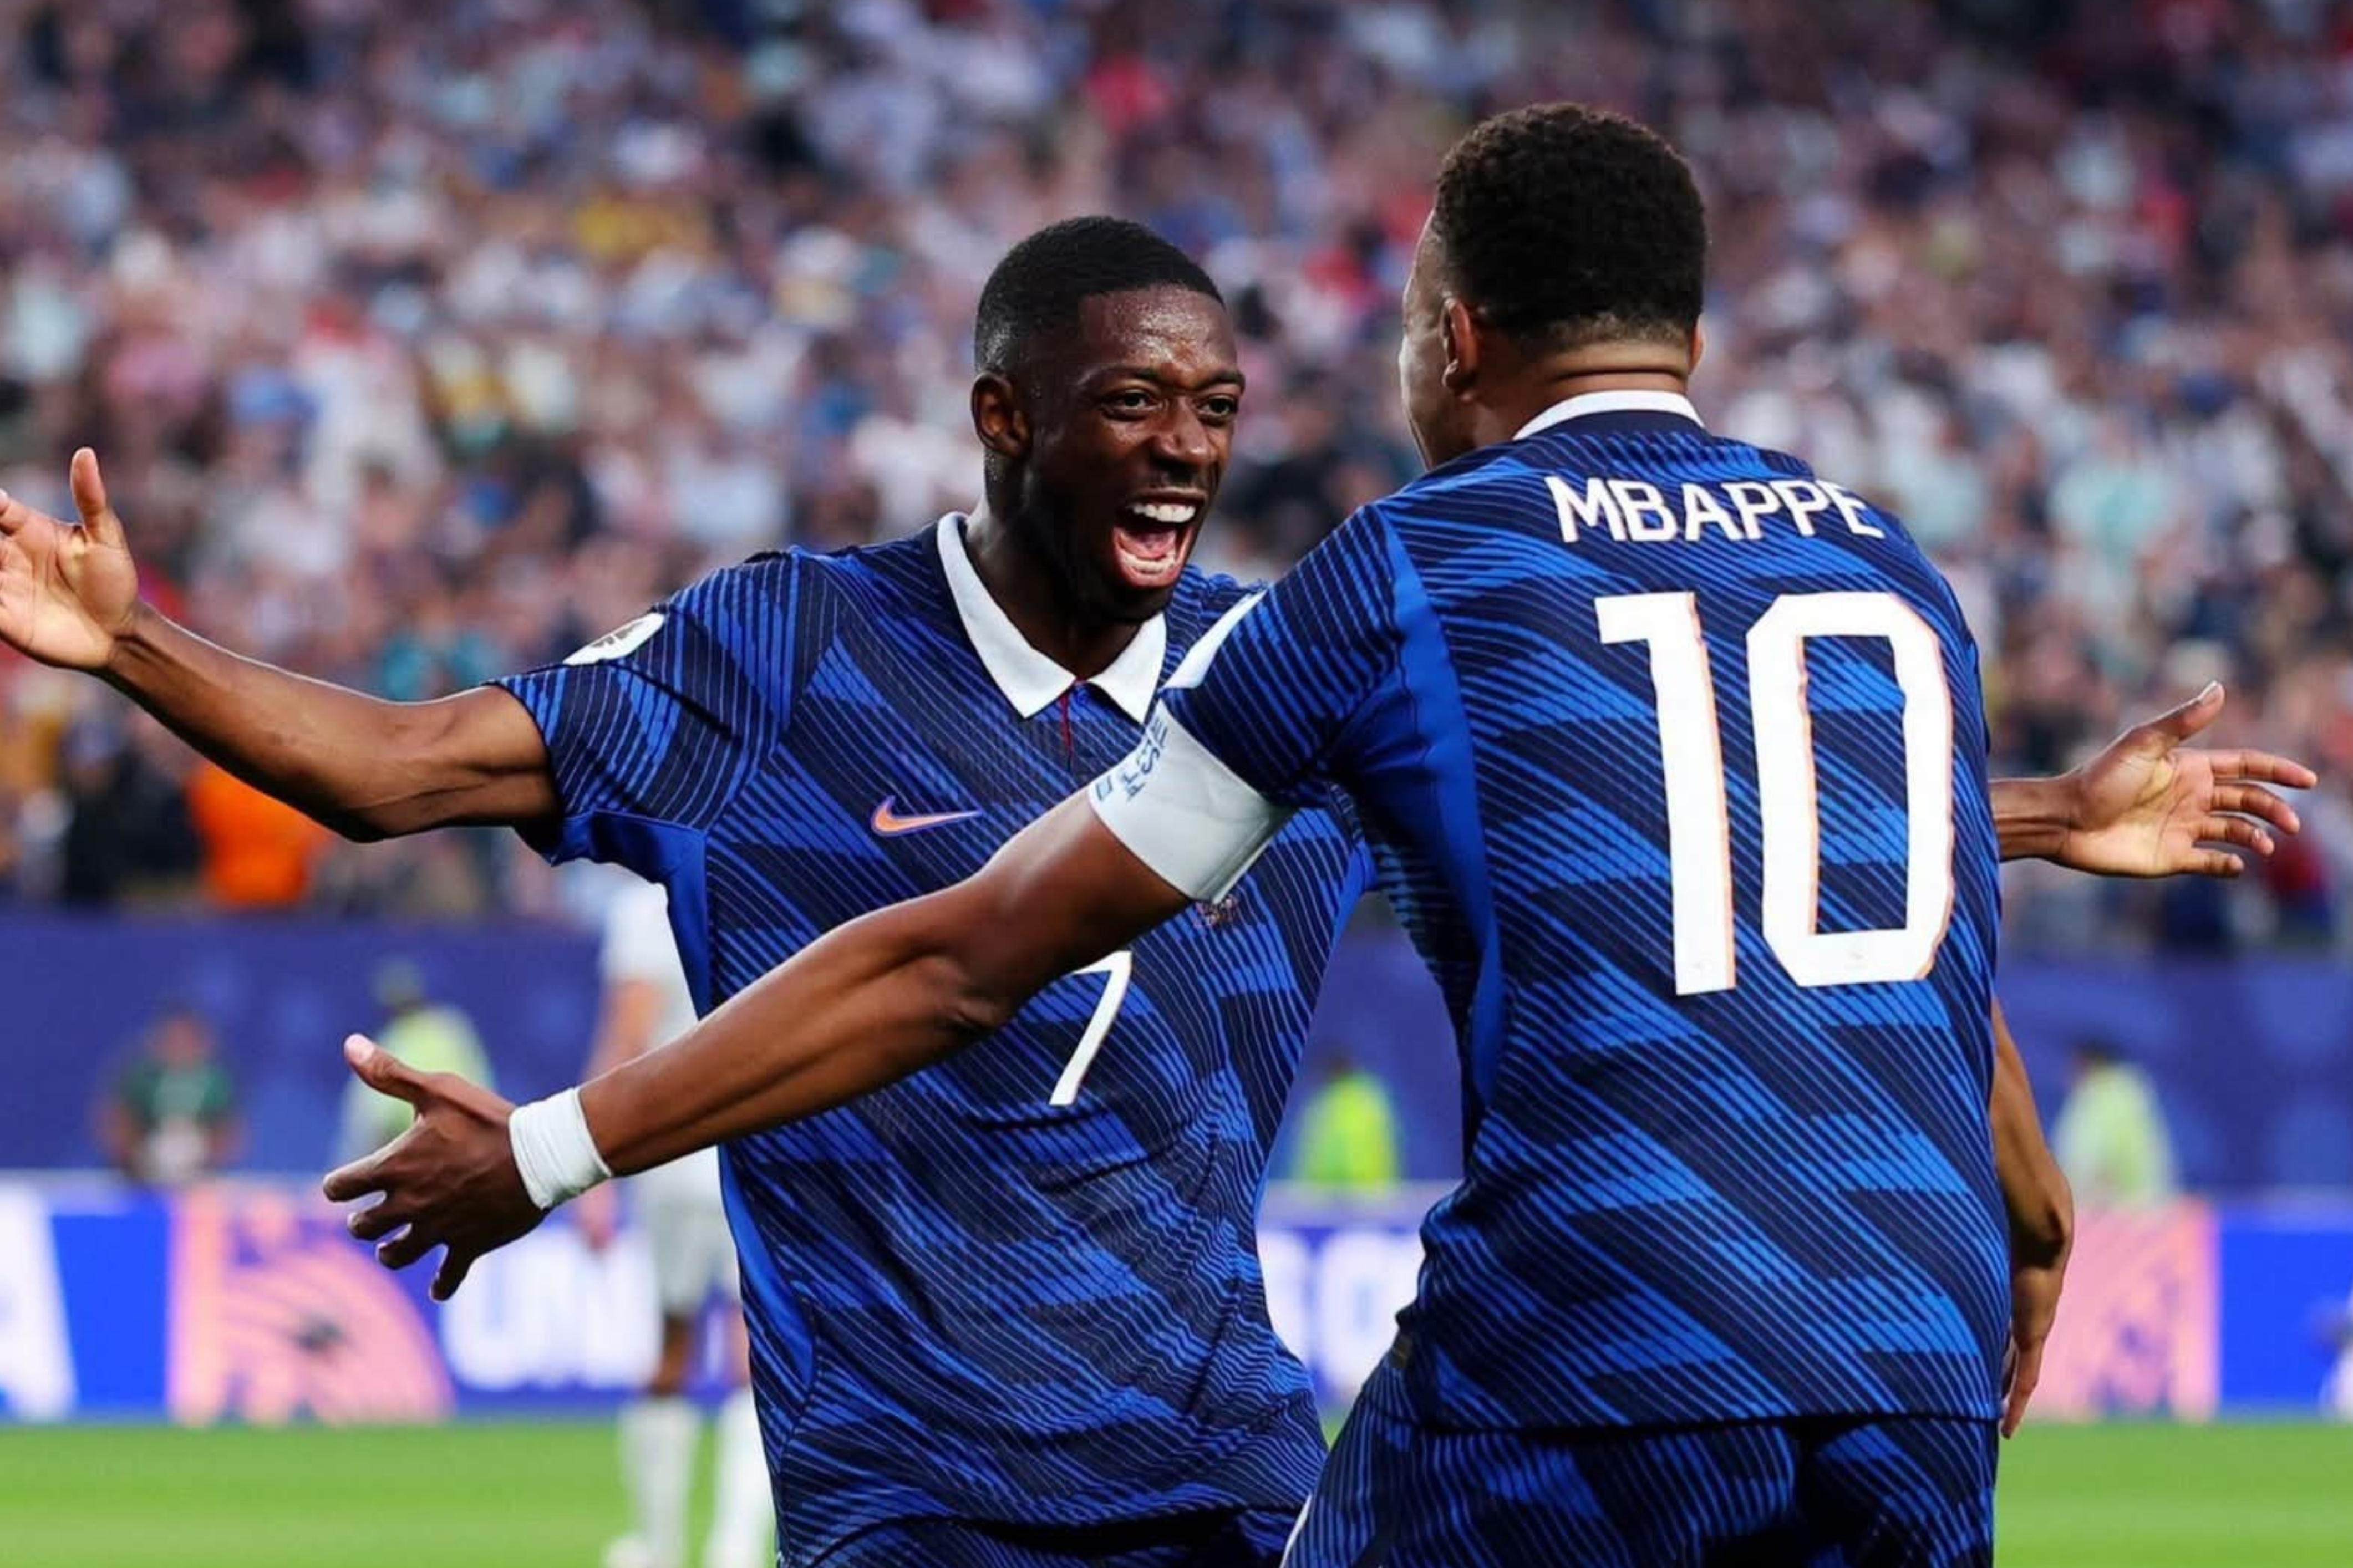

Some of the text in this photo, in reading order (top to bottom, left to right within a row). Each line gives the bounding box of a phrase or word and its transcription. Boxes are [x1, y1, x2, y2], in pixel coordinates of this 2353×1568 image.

[1544, 476, 1884, 543] MBAPPE
[1594, 590, 1954, 995] 10
[1049, 950, 1132, 1105] 7
